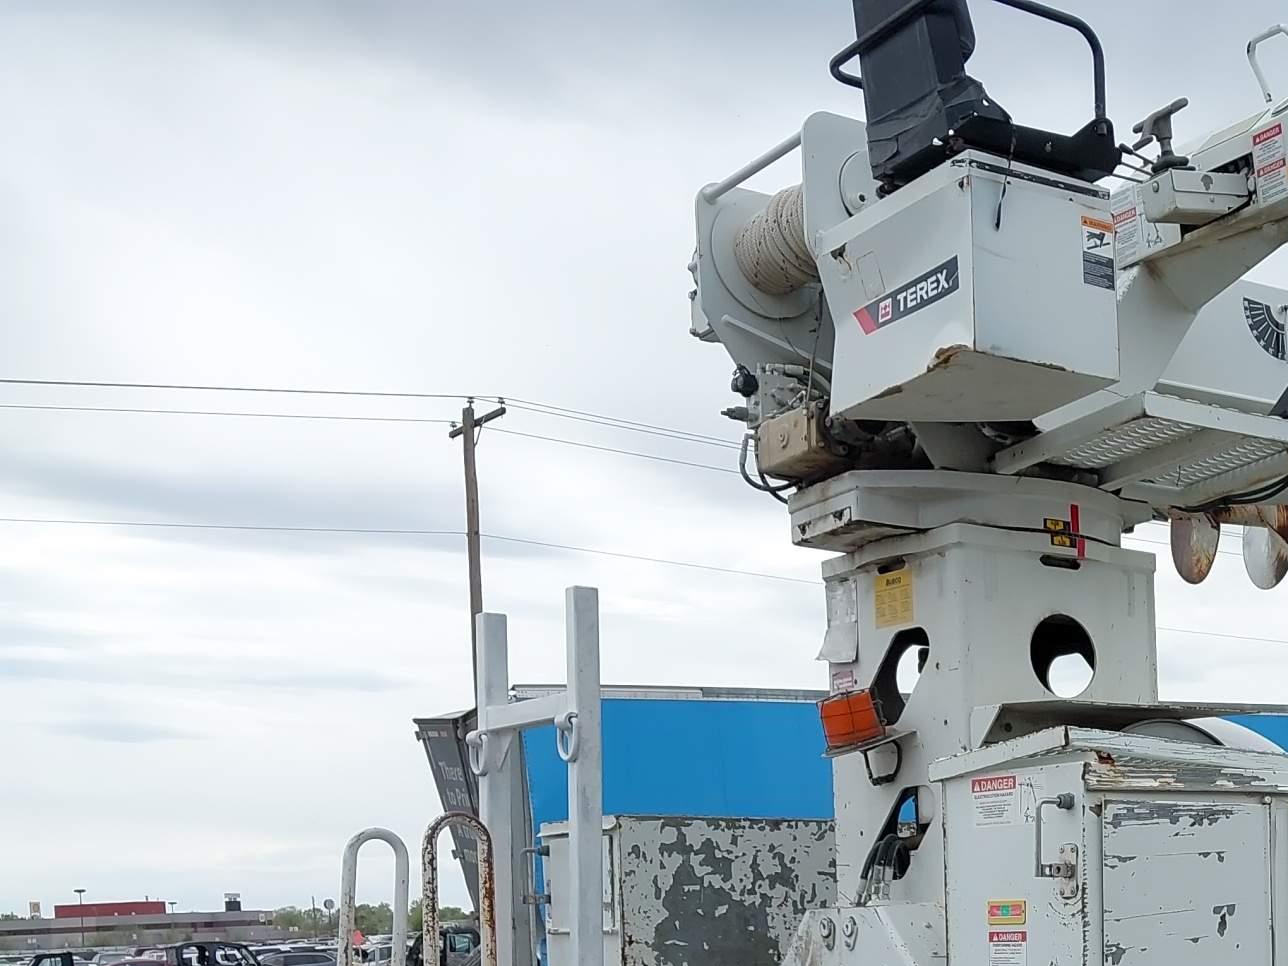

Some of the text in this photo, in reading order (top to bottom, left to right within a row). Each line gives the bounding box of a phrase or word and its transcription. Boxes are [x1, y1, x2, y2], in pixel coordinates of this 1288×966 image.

[896, 268, 949, 312] TEREX
[981, 779, 1014, 791] DANGER
[998, 933, 1023, 941] DANGER
